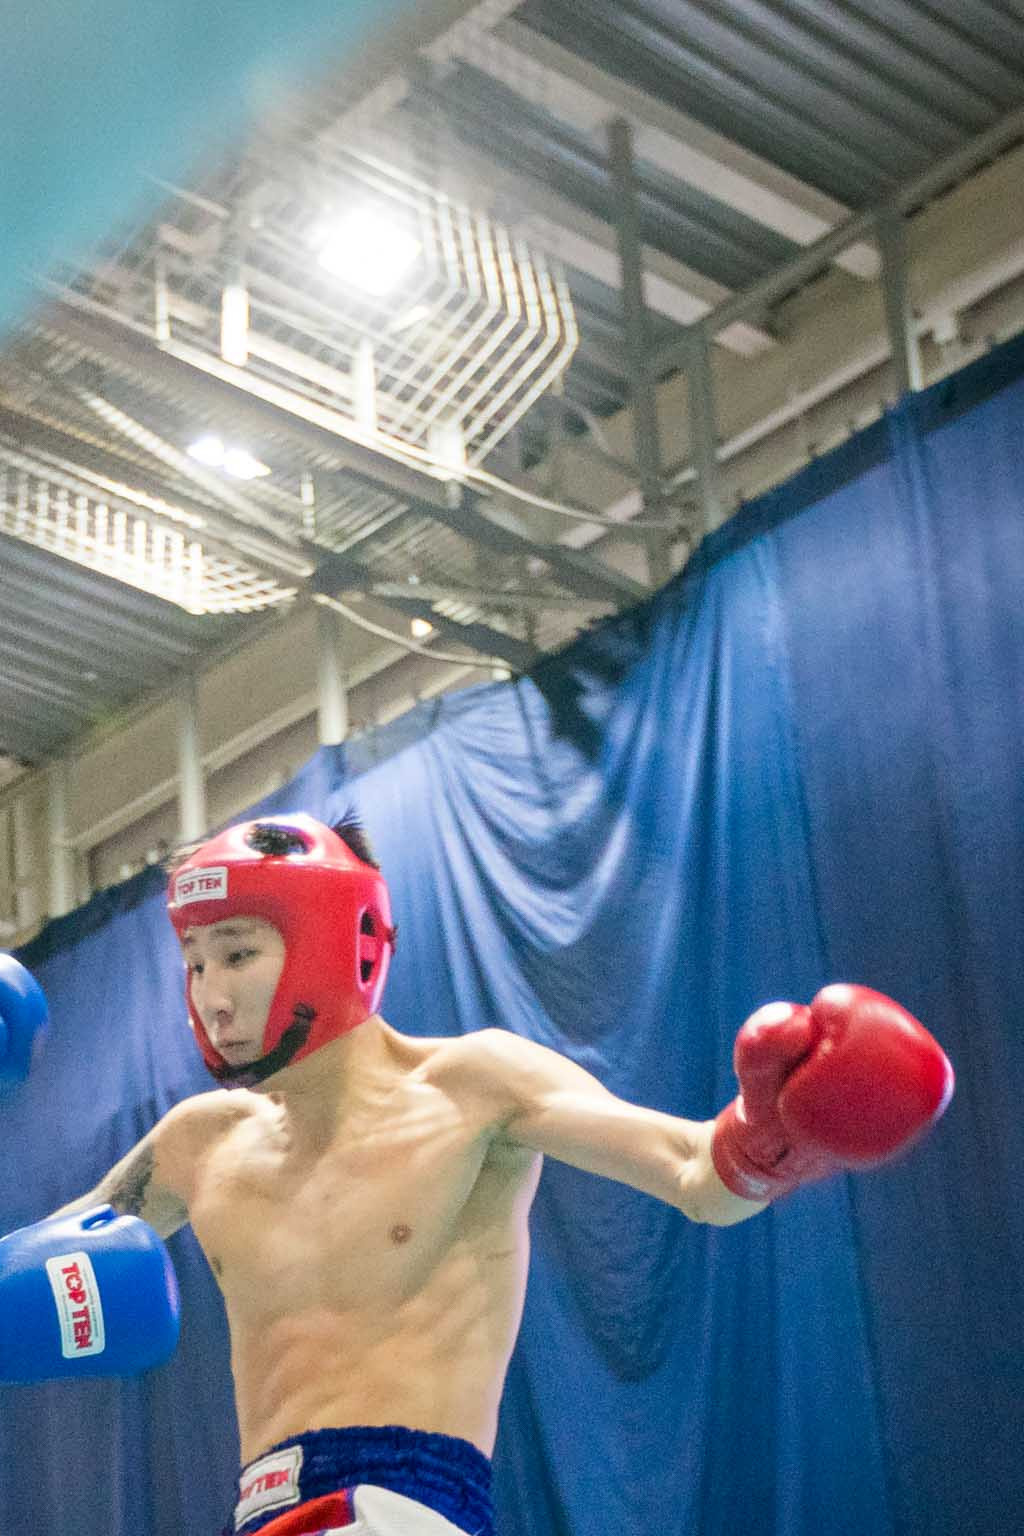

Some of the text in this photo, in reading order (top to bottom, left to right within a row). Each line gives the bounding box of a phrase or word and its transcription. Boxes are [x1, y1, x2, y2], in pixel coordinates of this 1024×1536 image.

[198, 877, 222, 891] TEN
[61, 1261, 87, 1304] TOP
[72, 1306, 93, 1350] TEN
